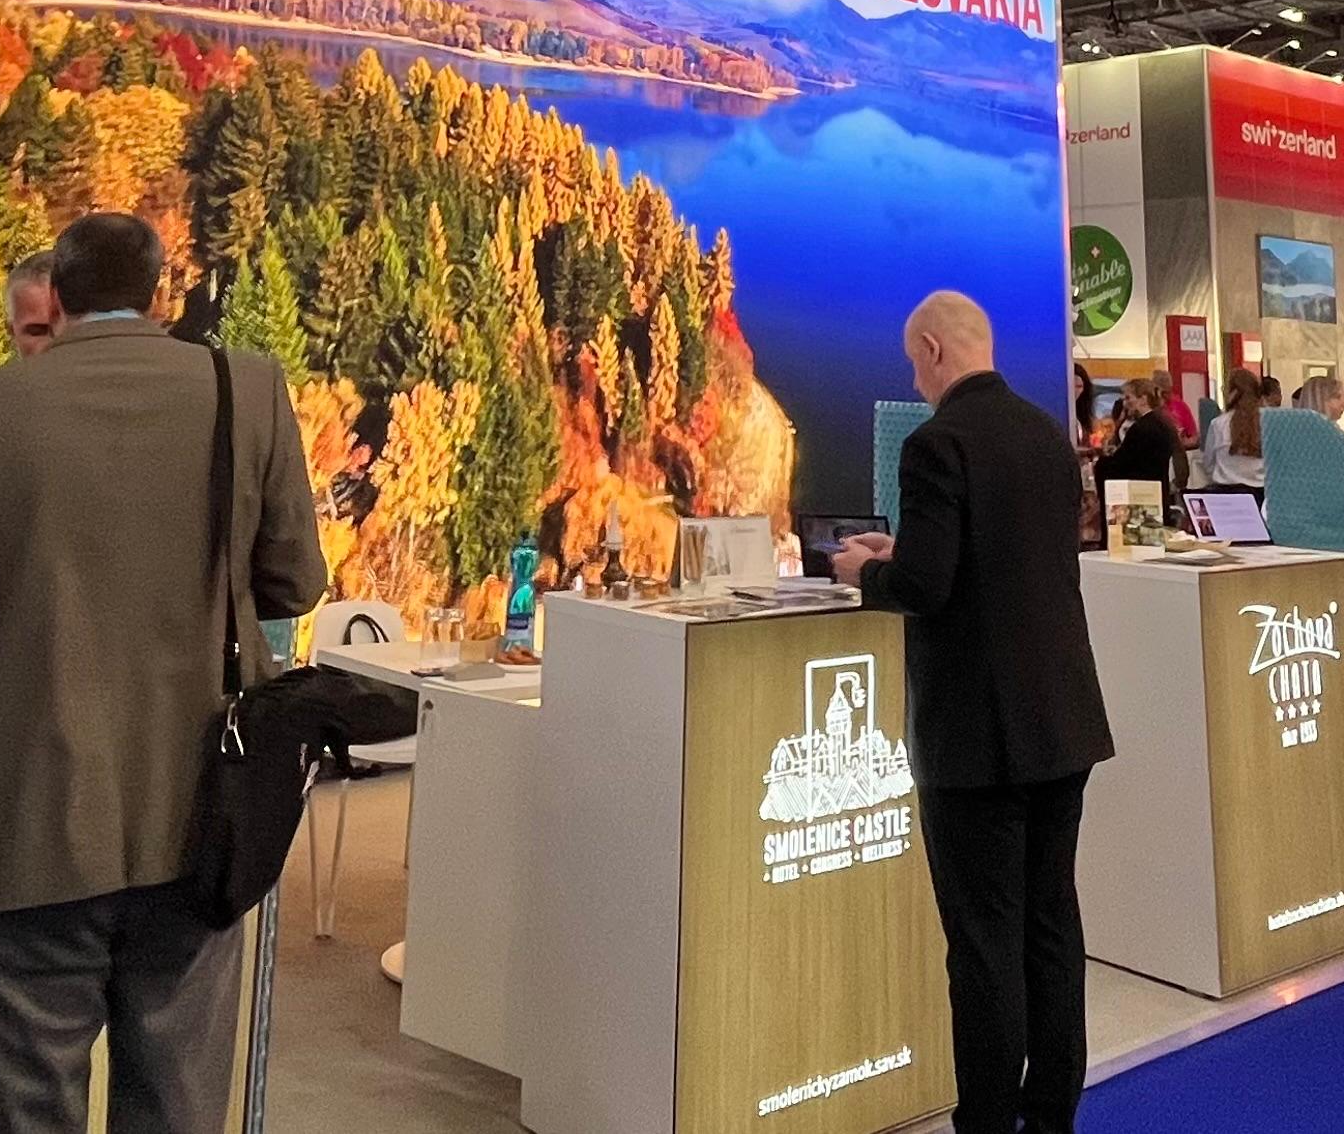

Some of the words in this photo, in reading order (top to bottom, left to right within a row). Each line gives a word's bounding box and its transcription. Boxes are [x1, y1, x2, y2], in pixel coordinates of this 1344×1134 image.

[1268, 658, 1322, 704] CHATA
[763, 818, 851, 865] SMOLENICE
[854, 806, 911, 846] CASTLE
[758, 1045, 912, 1117] smolenickyzamok.sav.sk
